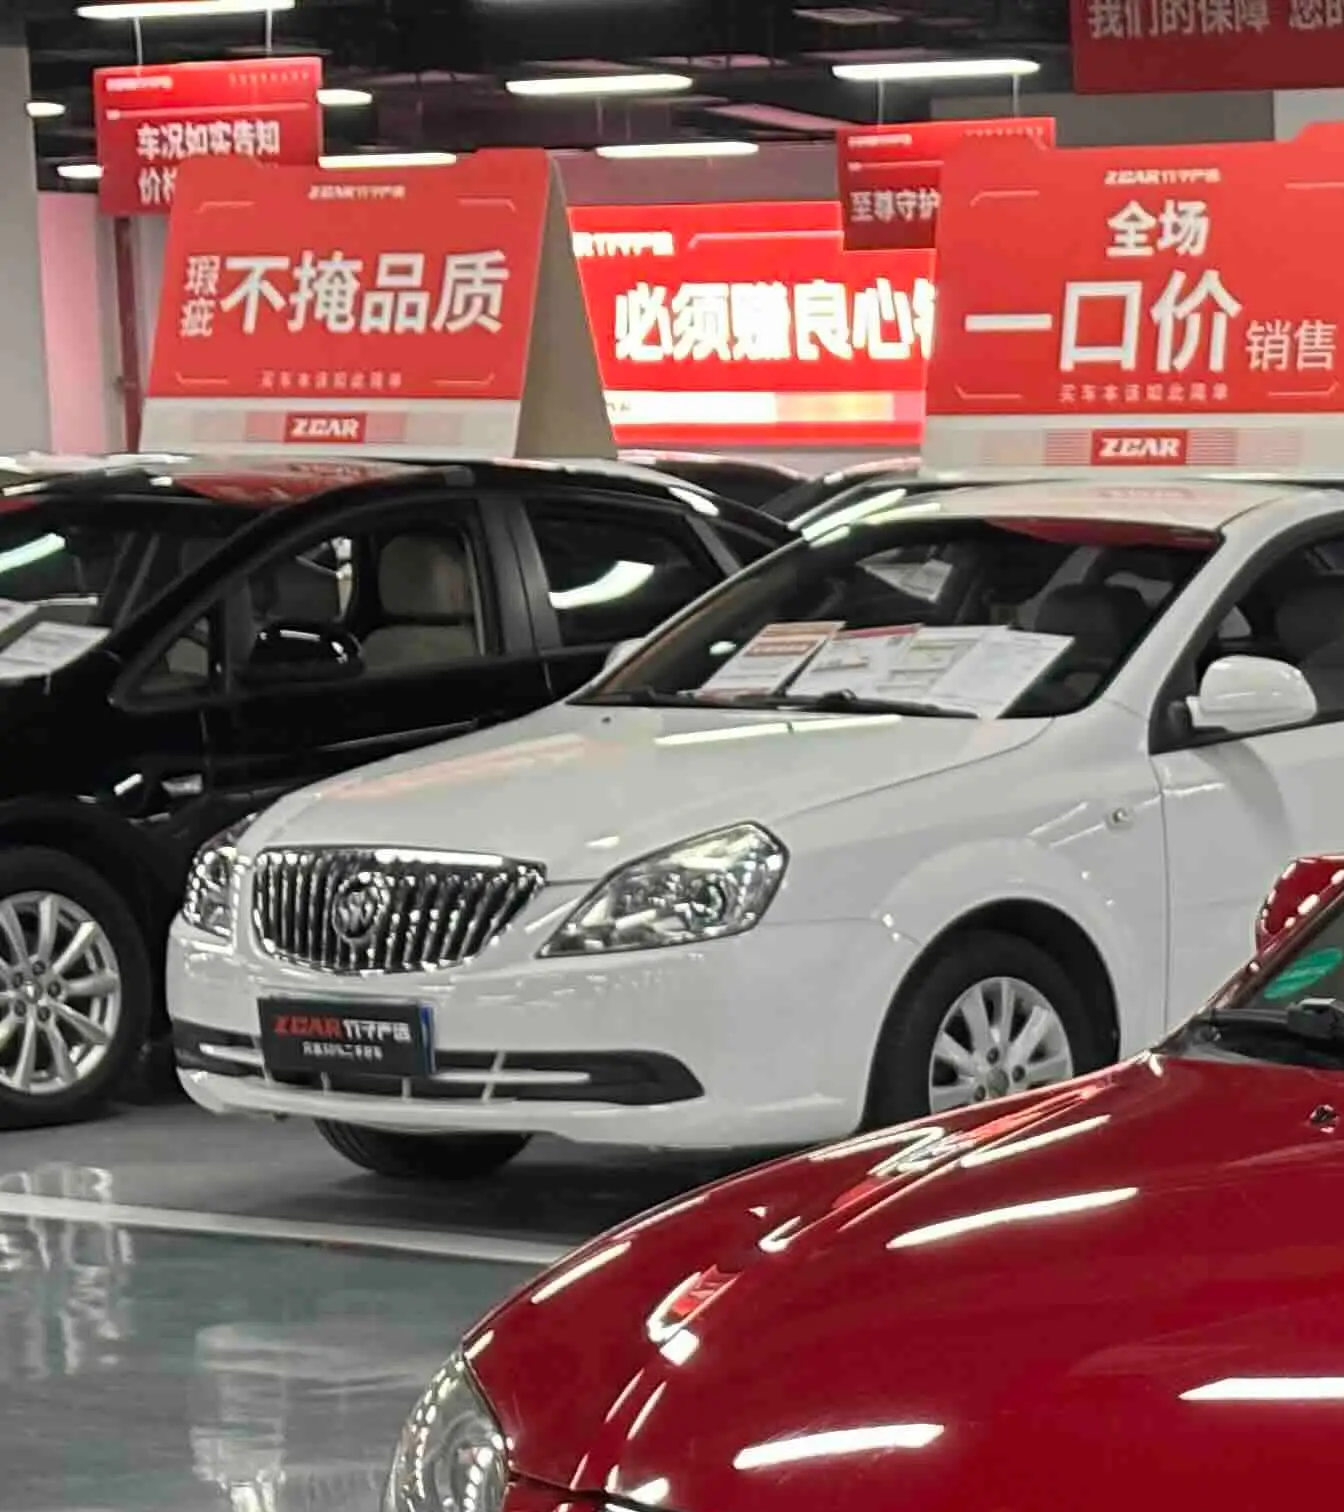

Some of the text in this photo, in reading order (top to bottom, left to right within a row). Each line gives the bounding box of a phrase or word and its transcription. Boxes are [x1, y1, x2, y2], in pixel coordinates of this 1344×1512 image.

[137, 118, 281, 160] 车况如实告知
[1106, 199, 1211, 258] 全场
[220, 248, 511, 335] 不掩品质
[964, 269, 1338, 373] 一口价 销售
[291, 417, 360, 437] ZCAR
[1099, 437, 1182, 458] ZCAR
